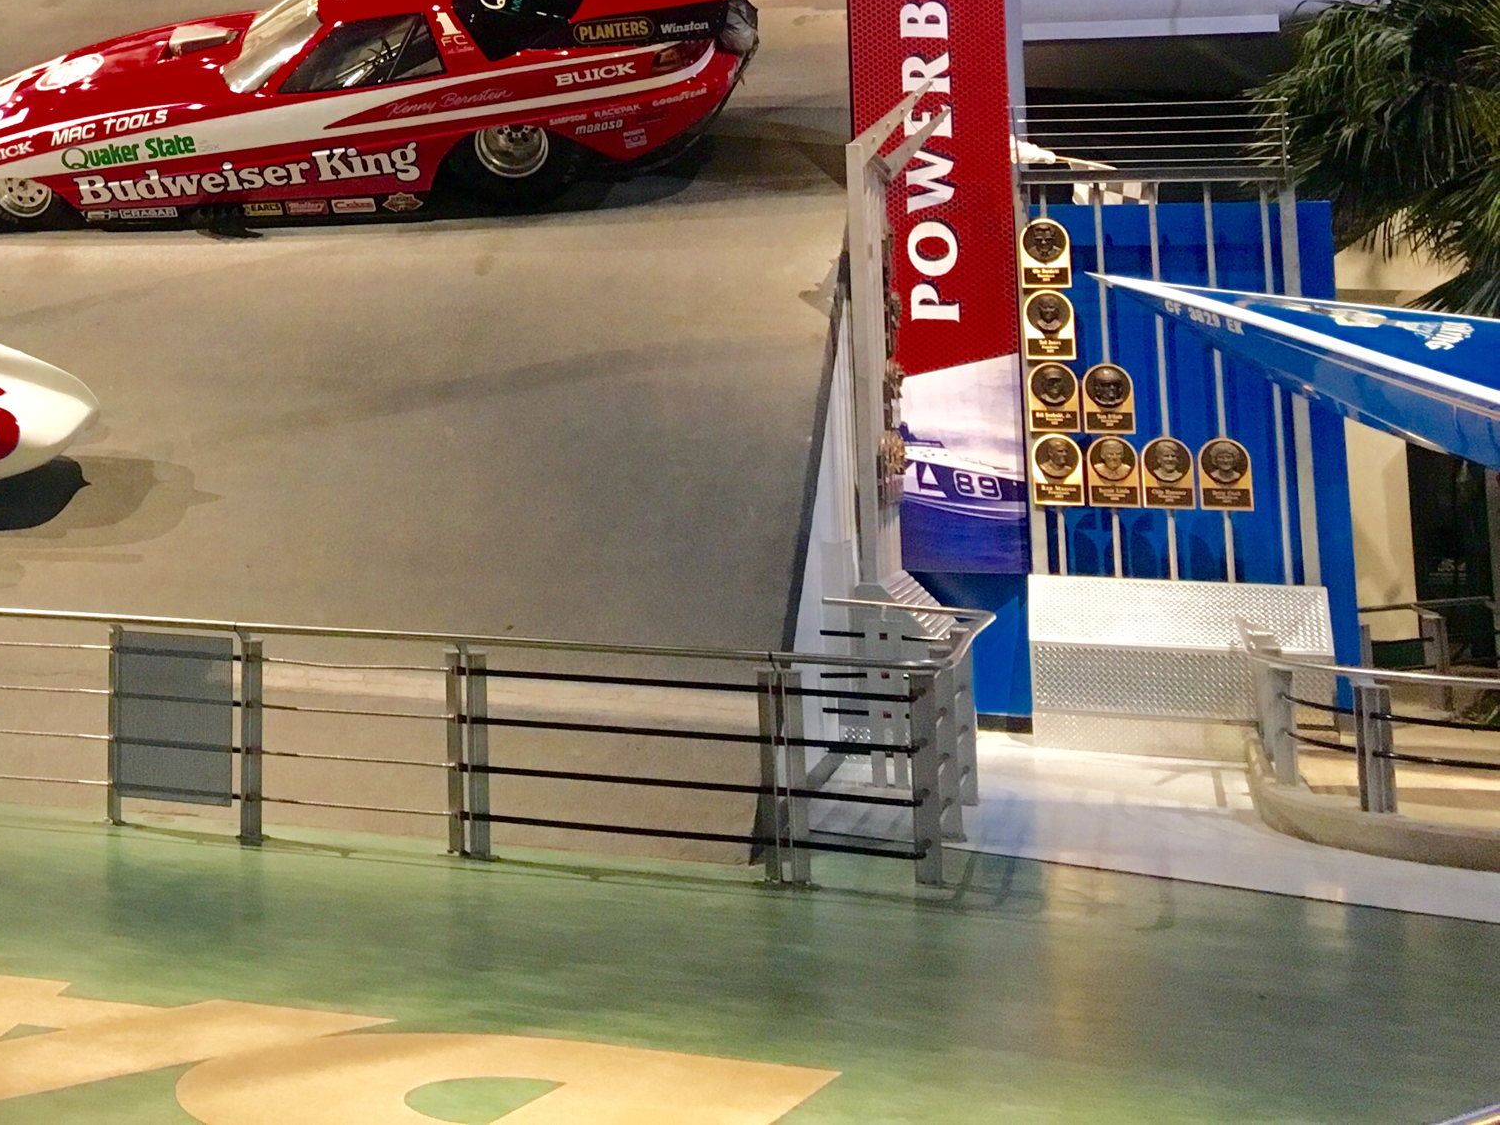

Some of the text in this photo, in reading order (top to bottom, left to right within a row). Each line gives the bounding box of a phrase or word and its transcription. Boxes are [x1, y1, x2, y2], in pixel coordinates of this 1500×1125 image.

[436, 12, 462, 36] 1
[579, 20, 650, 41] PLANTERS
[660, 20, 709, 35] Winston
[441, 35, 469, 47] FC
[554, 62, 637, 87] BUICK
[50, 109, 169, 147] MAC TOOLS
[61, 134, 197, 170] Quaker State
[72, 141, 421, 206] Budweiser King
[956, 473, 1000, 498] 89
